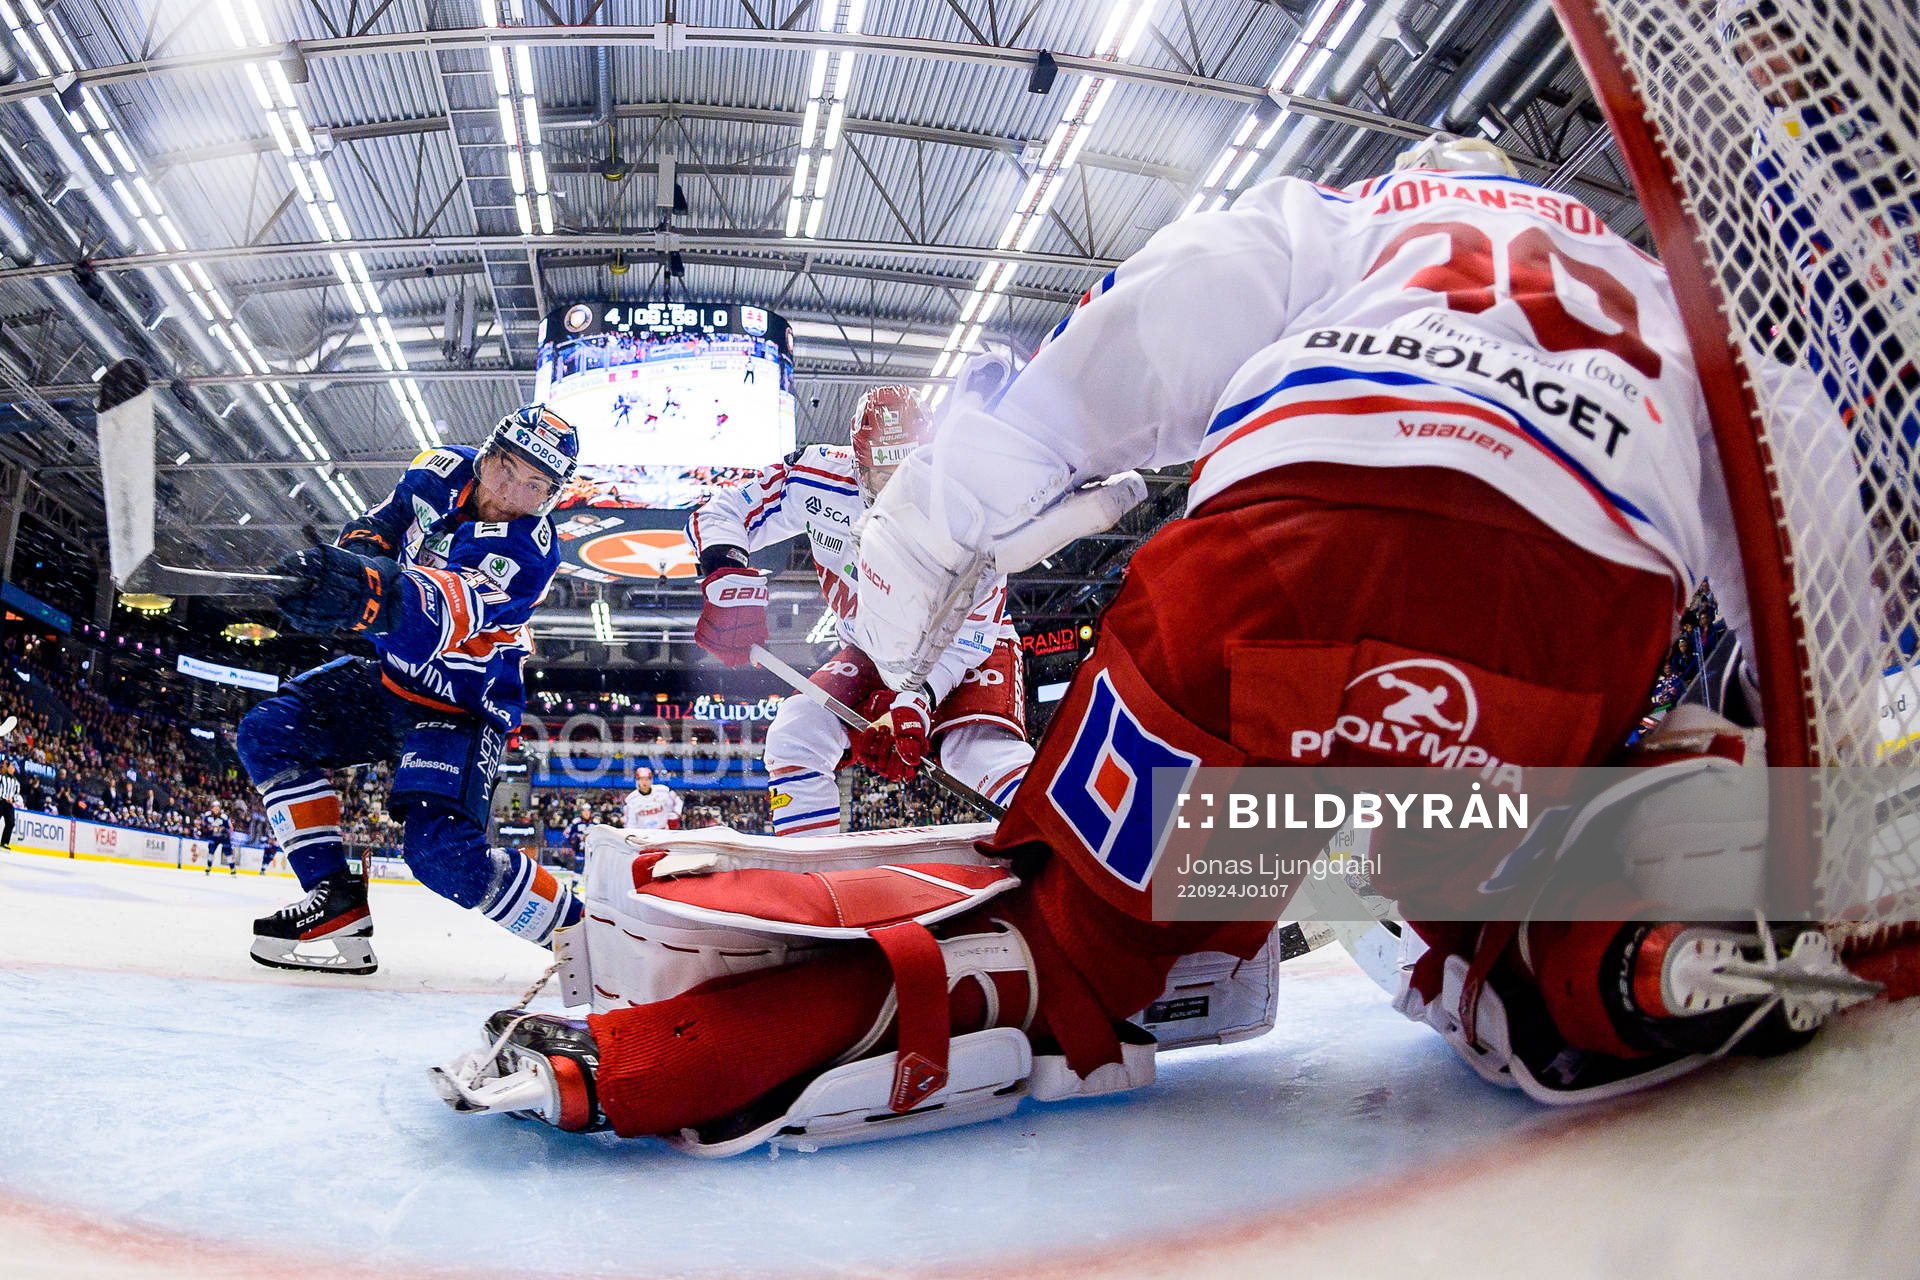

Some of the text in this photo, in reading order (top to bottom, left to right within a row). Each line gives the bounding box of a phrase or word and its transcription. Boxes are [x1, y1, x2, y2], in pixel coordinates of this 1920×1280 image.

[604, 308, 620, 325] 4
[713, 310, 728, 326] 0
[1304, 329, 1630, 459] BILBOLAGET
[425, 454, 455, 472] put
[531, 442, 563, 469] OBOS
[889, 447, 917, 460] LILI
[823, 507, 851, 527] SCA
[812, 528, 843, 552] LILIUM
[719, 587, 769, 601] BAU
[1022, 628, 1074, 651] RAND
[415, 721, 457, 730] CCM
[296, 910, 325, 928] CCM
[511, 900, 540, 932] STENA
